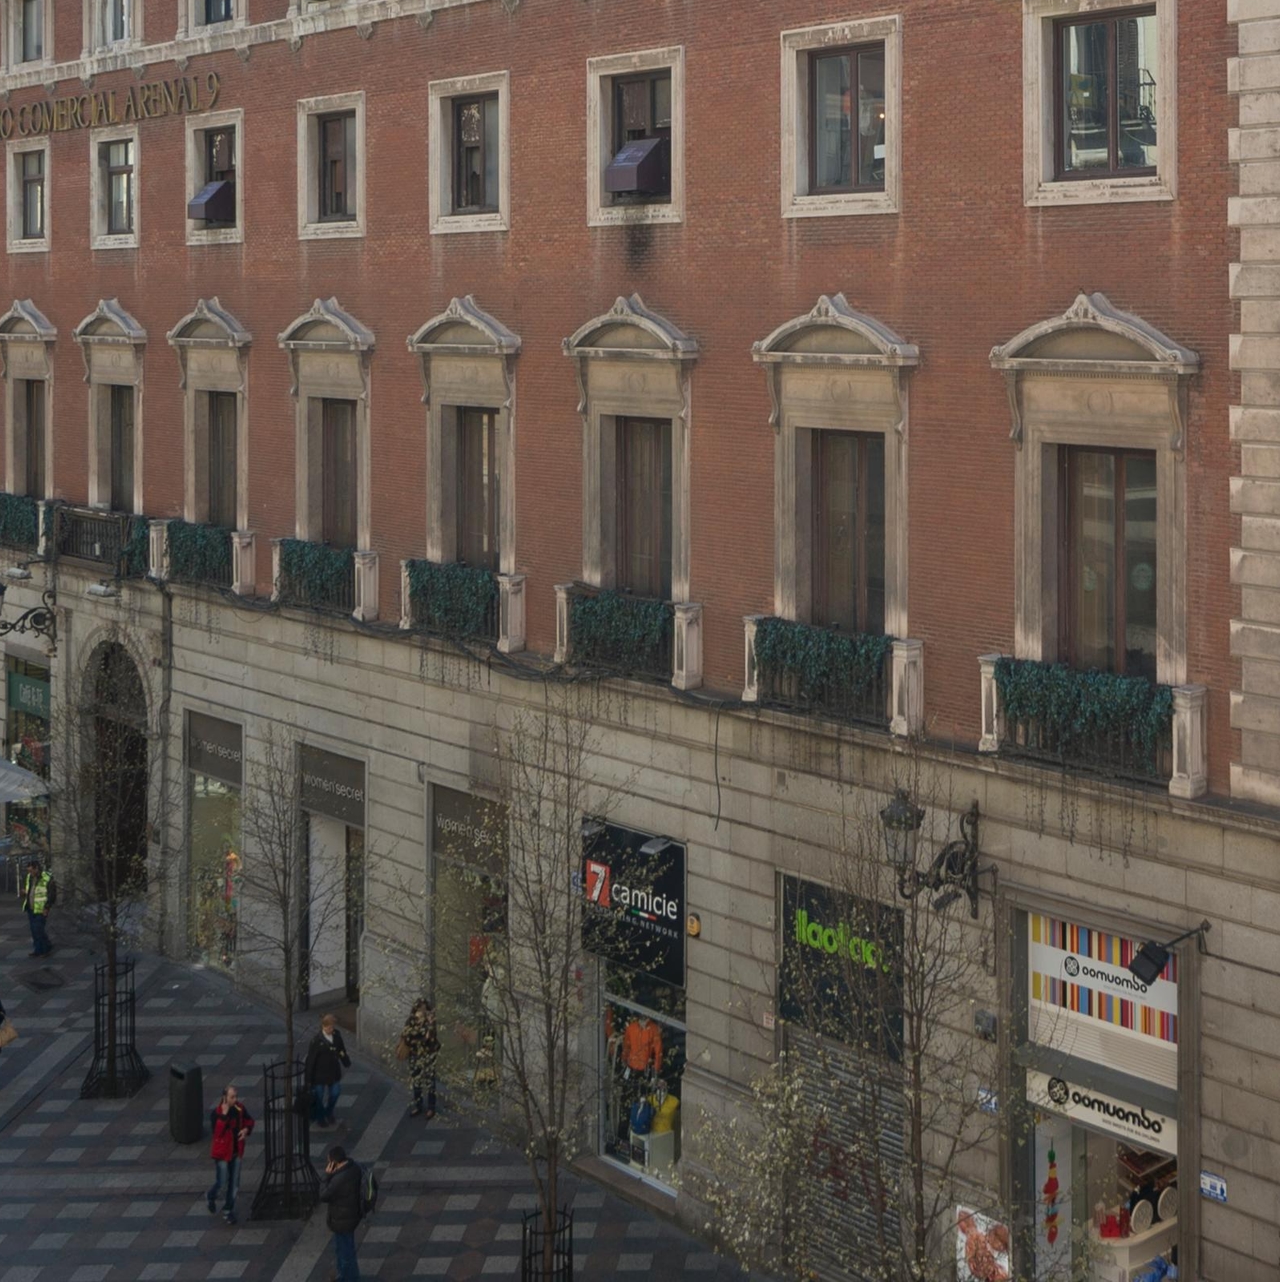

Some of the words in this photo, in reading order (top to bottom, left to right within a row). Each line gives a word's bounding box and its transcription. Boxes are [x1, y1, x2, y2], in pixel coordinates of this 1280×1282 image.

[19, 89, 117, 137] COMERCIAL
[125, 75, 202, 120] ARENAL
[206, 71, 220, 108] 9
[590, 862, 607, 902] 7
[611, 882, 678, 920] camicie
[640, 920, 679, 940] NETWORK
